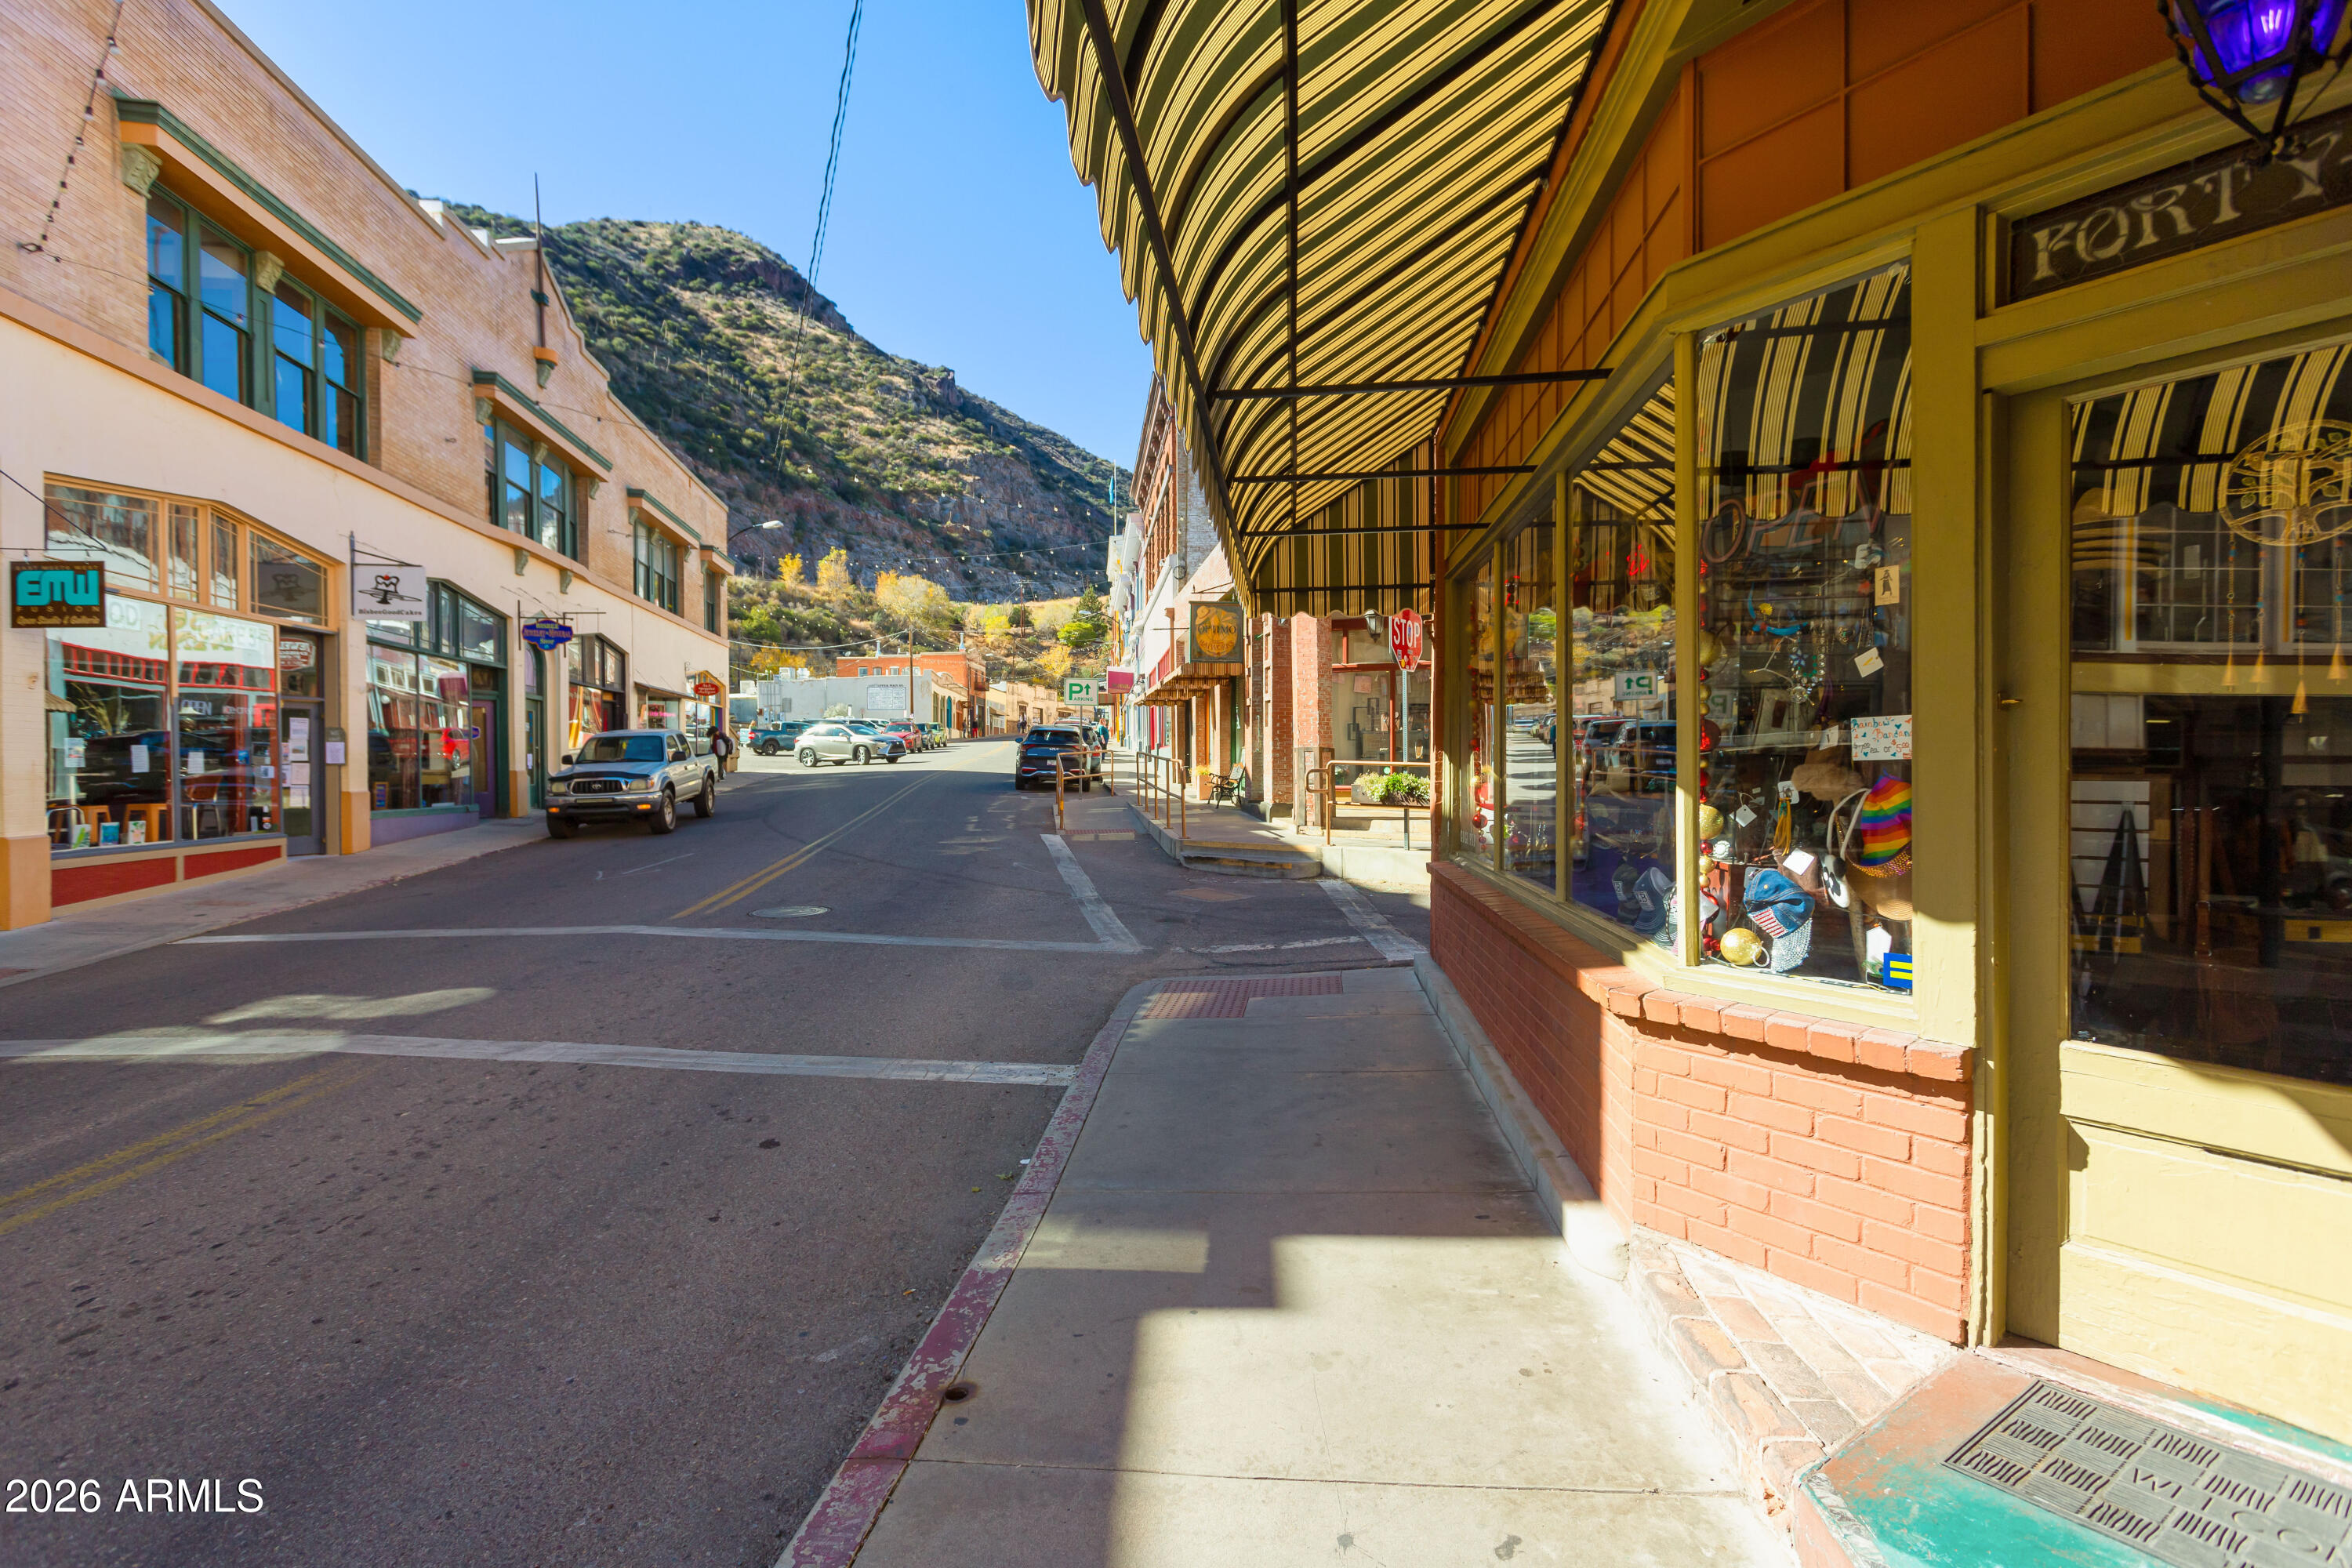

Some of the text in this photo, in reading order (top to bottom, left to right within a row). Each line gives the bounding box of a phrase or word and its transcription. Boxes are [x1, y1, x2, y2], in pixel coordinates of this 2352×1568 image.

[1702, 462, 1894, 563] OPEN
[1198, 625, 1236, 634] OPTIMO
[1393, 617, 1421, 648] STOP
[1851, 717, 1889, 728] Rainbow
